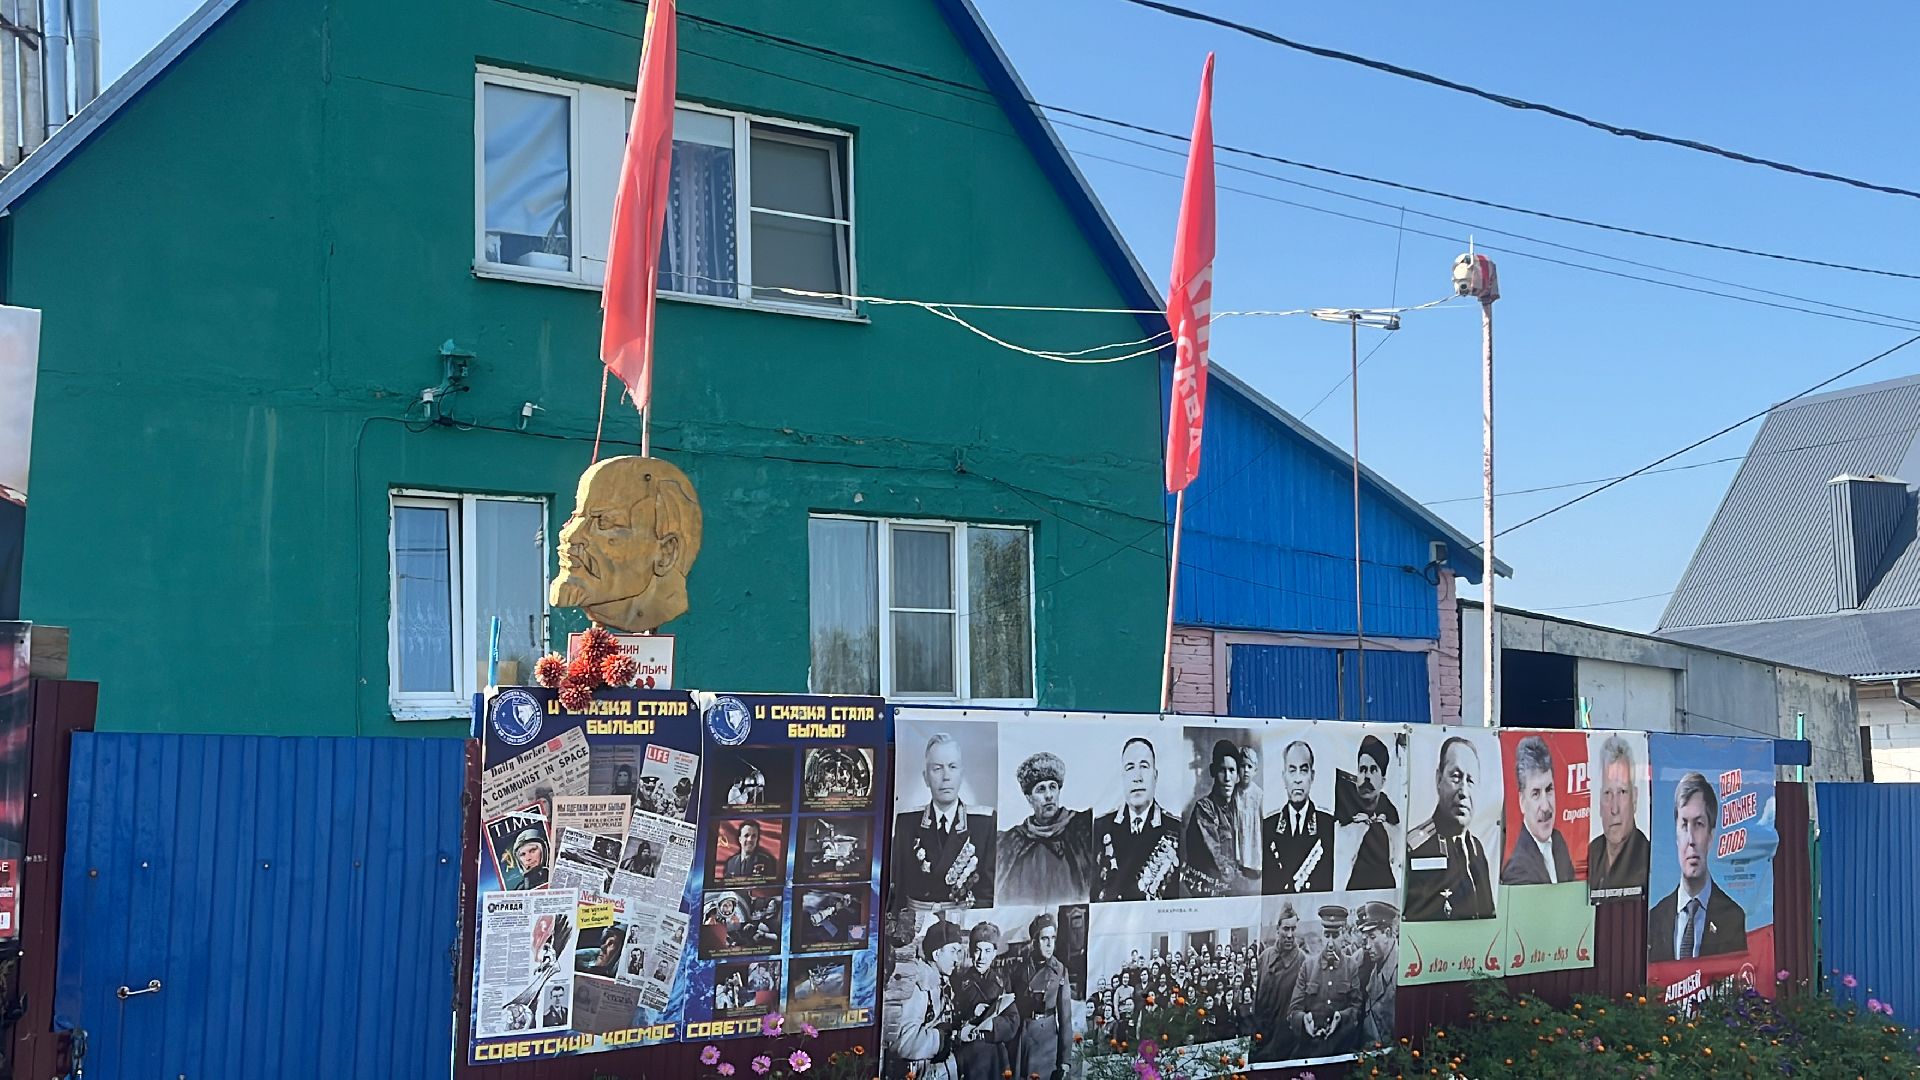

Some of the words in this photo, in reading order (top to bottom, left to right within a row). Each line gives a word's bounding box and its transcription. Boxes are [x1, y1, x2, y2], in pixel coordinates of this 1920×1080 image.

[548, 700, 559, 715] И
[566, 700, 631, 715] АЗКА
[638, 701, 688, 716] СТАЛА
[755, 705, 766, 719] И
[771, 705, 826, 720] СКАЗКА
[831, 706, 875, 721] СТАЛА
[586, 720, 655, 735] БЫЛЬЮ!
[788, 724, 845, 738] БЫЛЬЮ!
[491, 761, 515, 778] Daily
[516, 745, 547, 765] Worker
[647, 747, 669, 763] LIFE
[491, 771, 540, 801] COMMUNIST
[544, 764, 555, 775] IN
[558, 746, 589, 769] SPACE
[1721, 770, 1741, 798] ДЕЛА
[1722, 793, 1756, 827] СИЛЬНЕЕ
[1718, 829, 1746, 857] СЛОВ
[495, 903, 523, 911] ПРАВДА
[1665, 969, 1701, 1003] АЛЕКСЕЙ
[474, 1034, 595, 1061] СОВЕТСКИЙ
[602, 1023, 676, 1046] КОСМОС
